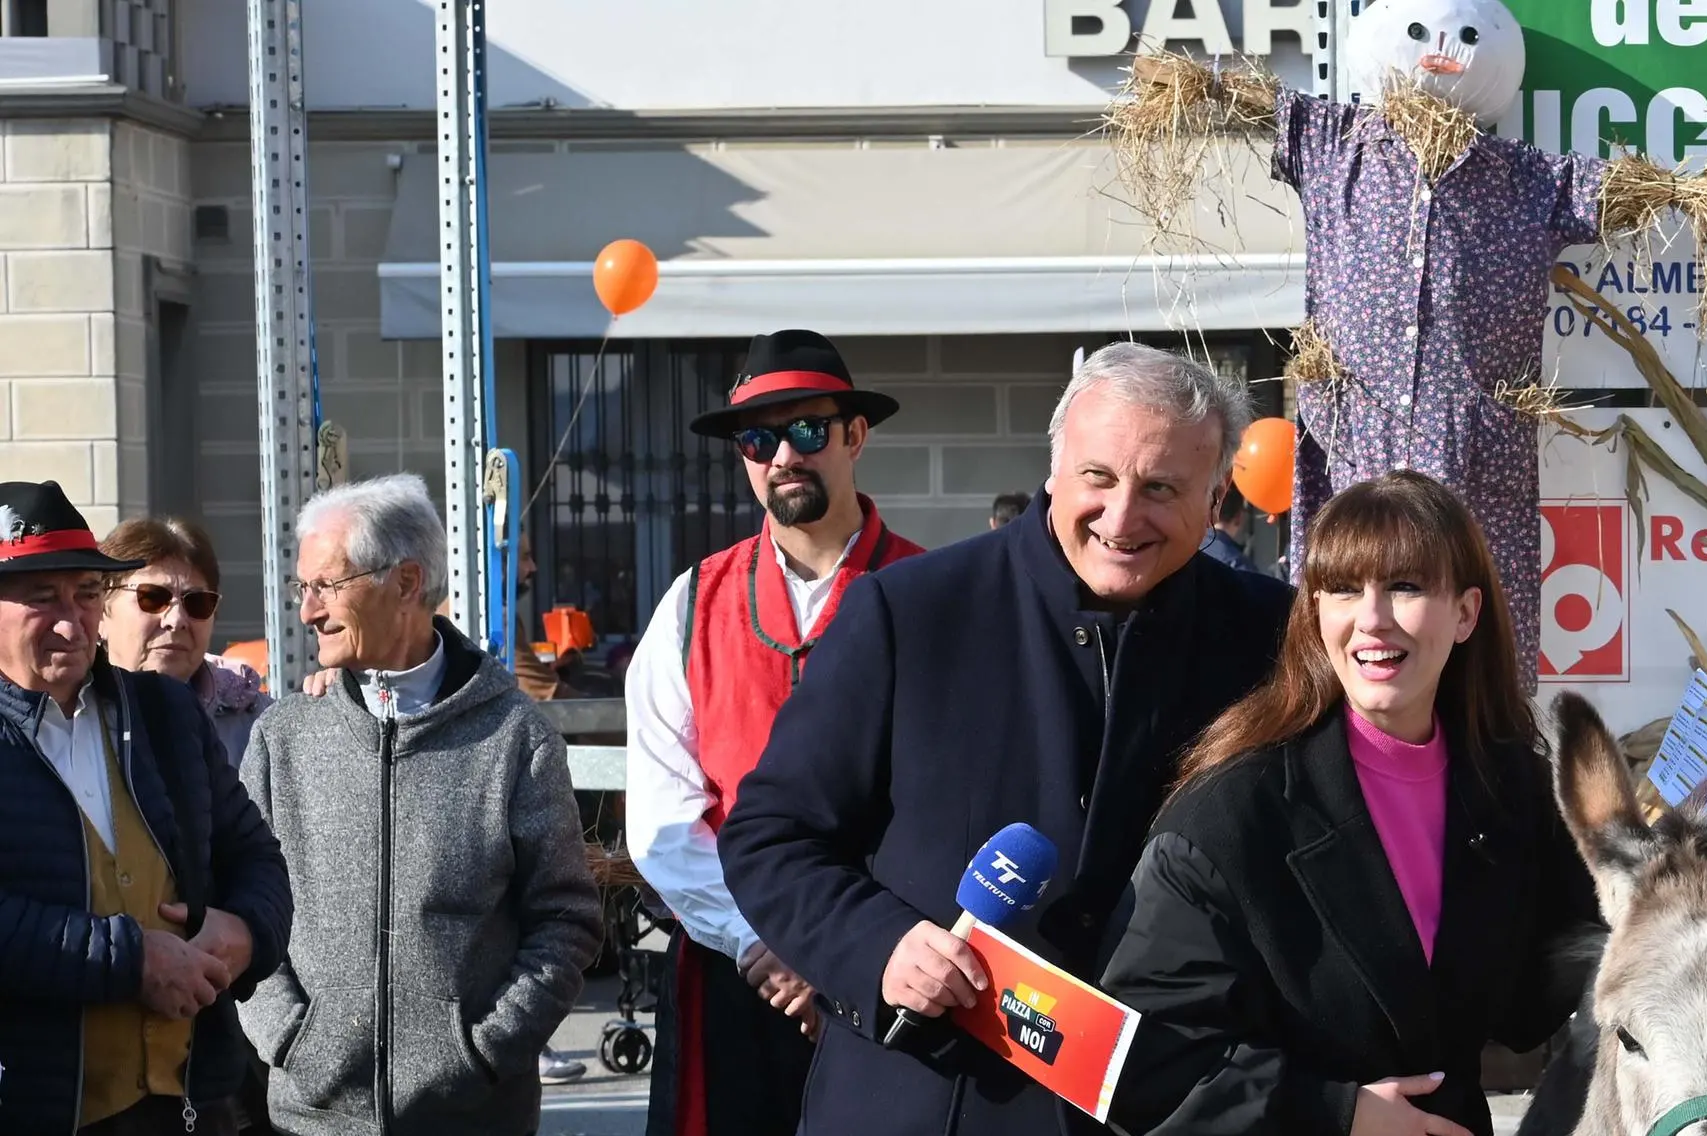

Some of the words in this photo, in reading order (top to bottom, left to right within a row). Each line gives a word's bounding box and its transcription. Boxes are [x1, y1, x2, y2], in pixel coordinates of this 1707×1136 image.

[972, 869, 1016, 905] TELETUTTO
[1002, 996, 1031, 1020] PIAZZA
[1039, 1017, 1052, 1028] con
[1020, 1026, 1047, 1054] NOI
